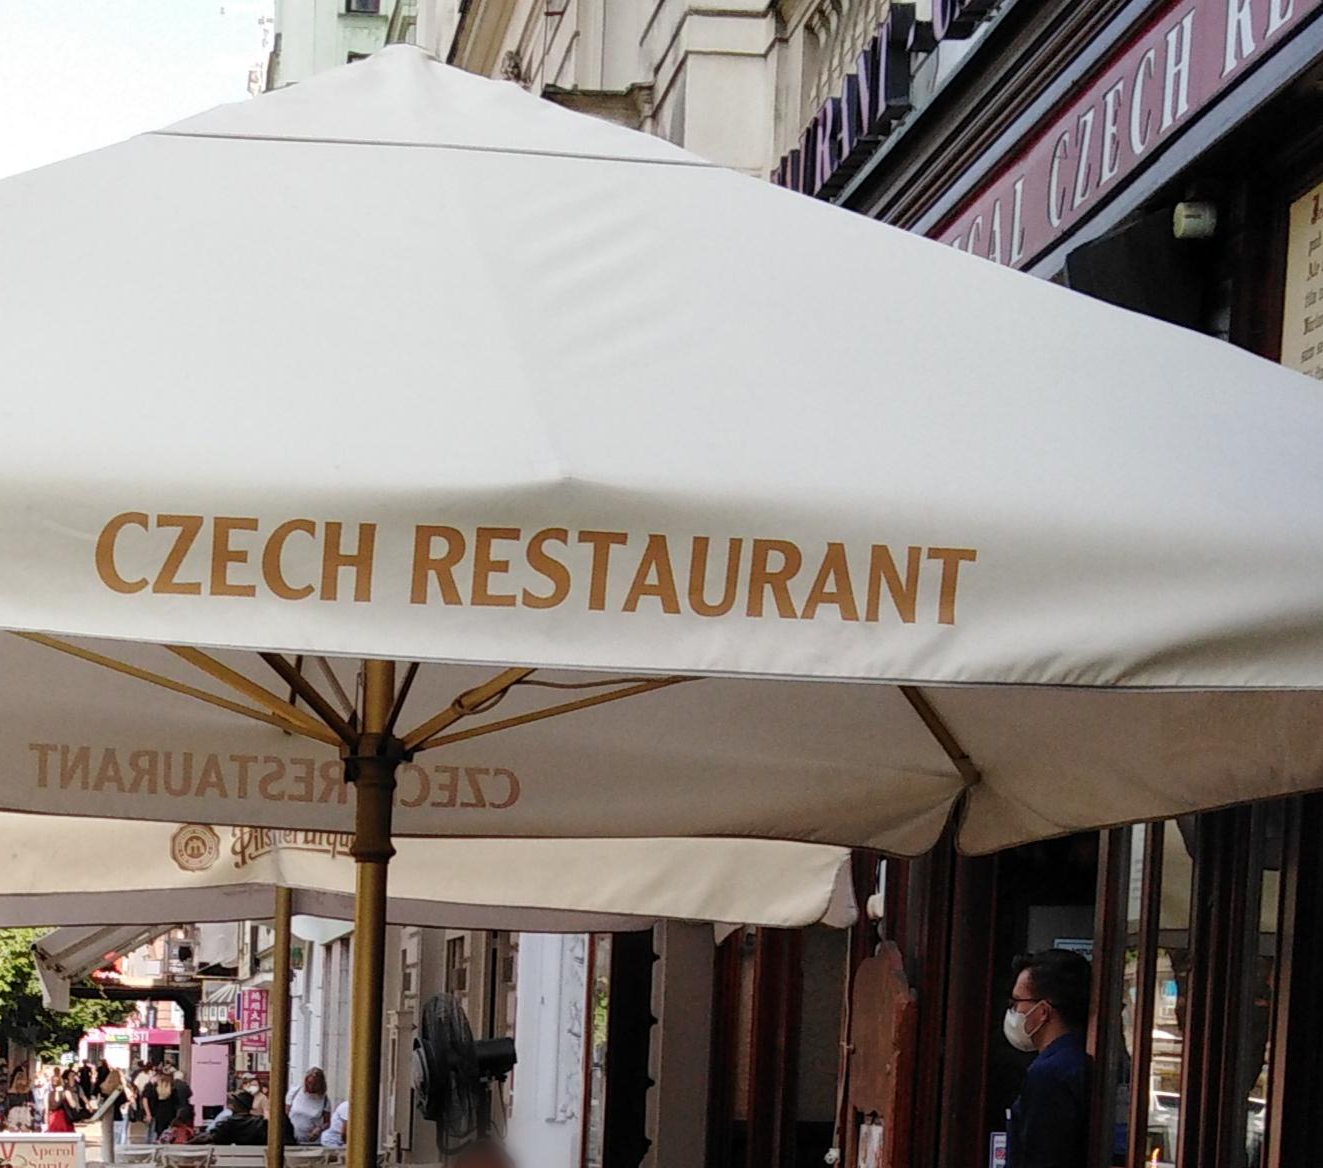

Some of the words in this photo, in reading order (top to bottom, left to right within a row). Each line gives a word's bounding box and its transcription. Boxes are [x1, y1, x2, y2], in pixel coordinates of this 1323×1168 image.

[1048, 8, 1196, 229] CZECH
[94, 511, 377, 602] CZECH
[409, 524, 977, 626] RESTAURANT
[31, 1144, 75, 1160] Aperol
